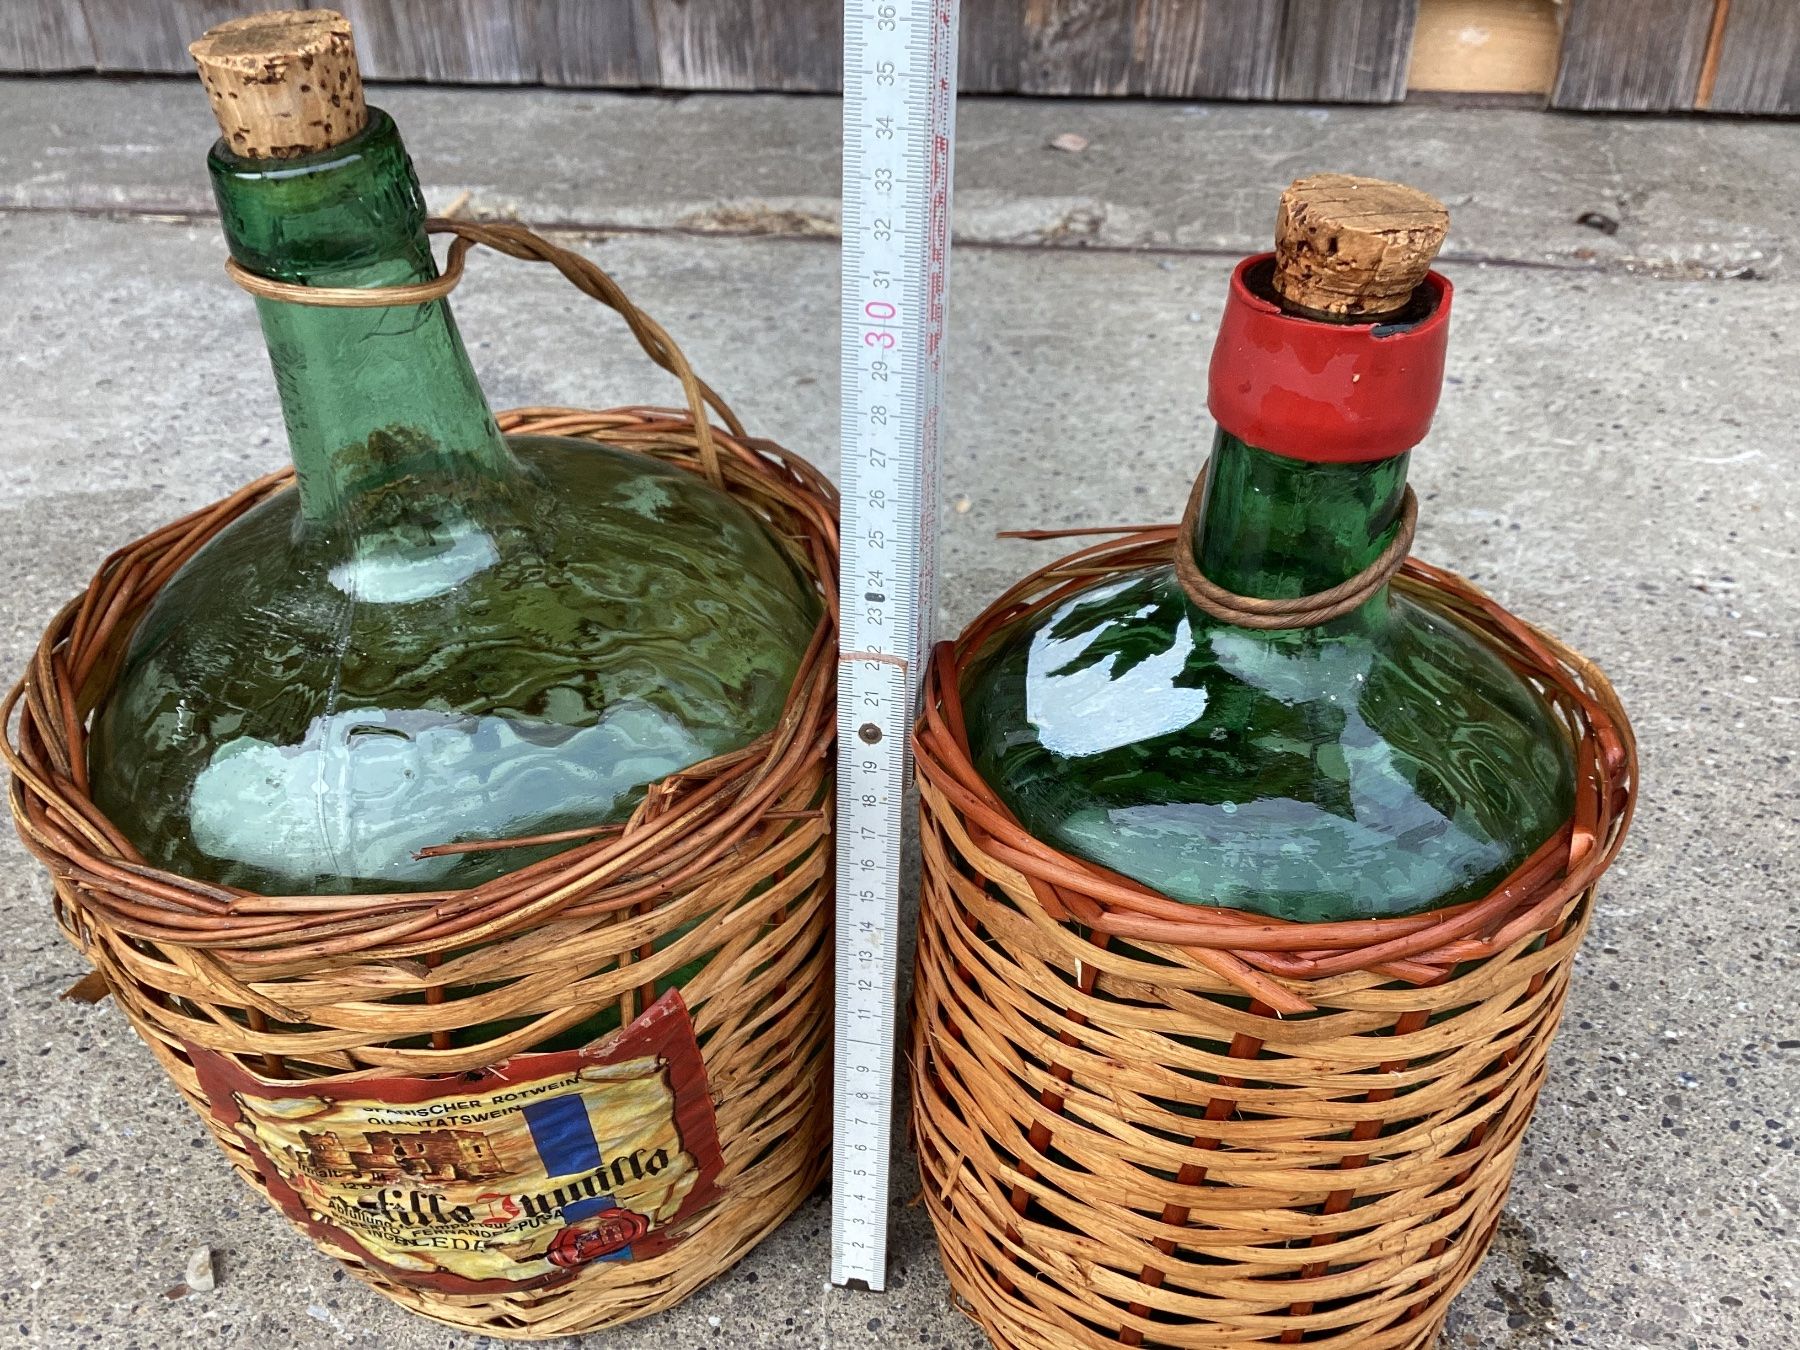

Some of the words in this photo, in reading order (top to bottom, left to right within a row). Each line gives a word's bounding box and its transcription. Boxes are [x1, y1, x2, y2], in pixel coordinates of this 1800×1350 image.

[877, 5, 897, 32] 36
[876, 61, 895, 86] 35
[875, 115, 893, 140] 34
[874, 167, 892, 192] 33
[873, 217, 891, 241] 32
[872, 270, 890, 289] 31
[865, 301, 896, 350] 30
[871, 361, 888, 383] 29
[870, 405, 887, 426] 28
[869, 447, 887, 469] 27
[868, 489, 886, 510] 26
[867, 528, 885, 550] 25
[867, 569, 885, 588] 24
[866, 606, 883, 626] 23
[864, 690, 880, 707] 21
[862, 761, 878, 775] 19
[861, 794, 877, 809] 18
[861, 827, 876, 841] 17
[861, 858, 875, 872] 16
[860, 890, 875, 903] 15
[859, 920, 874, 934] 14
[858, 950, 873, 963] 13
[857, 978, 873, 991] 12
[857, 1008, 871, 1020] 11
[856, 1065, 870, 1073] 9
[492, 1077, 580, 1105] ROTWEIN
[855, 1091, 870, 1100] 8
[855, 1117, 869, 1125] 7
[854, 1143, 868, 1152] 6
[853, 1169, 867, 1177] 5
[852, 1217, 866, 1225] 3
[852, 1241, 865, 1249] 2
